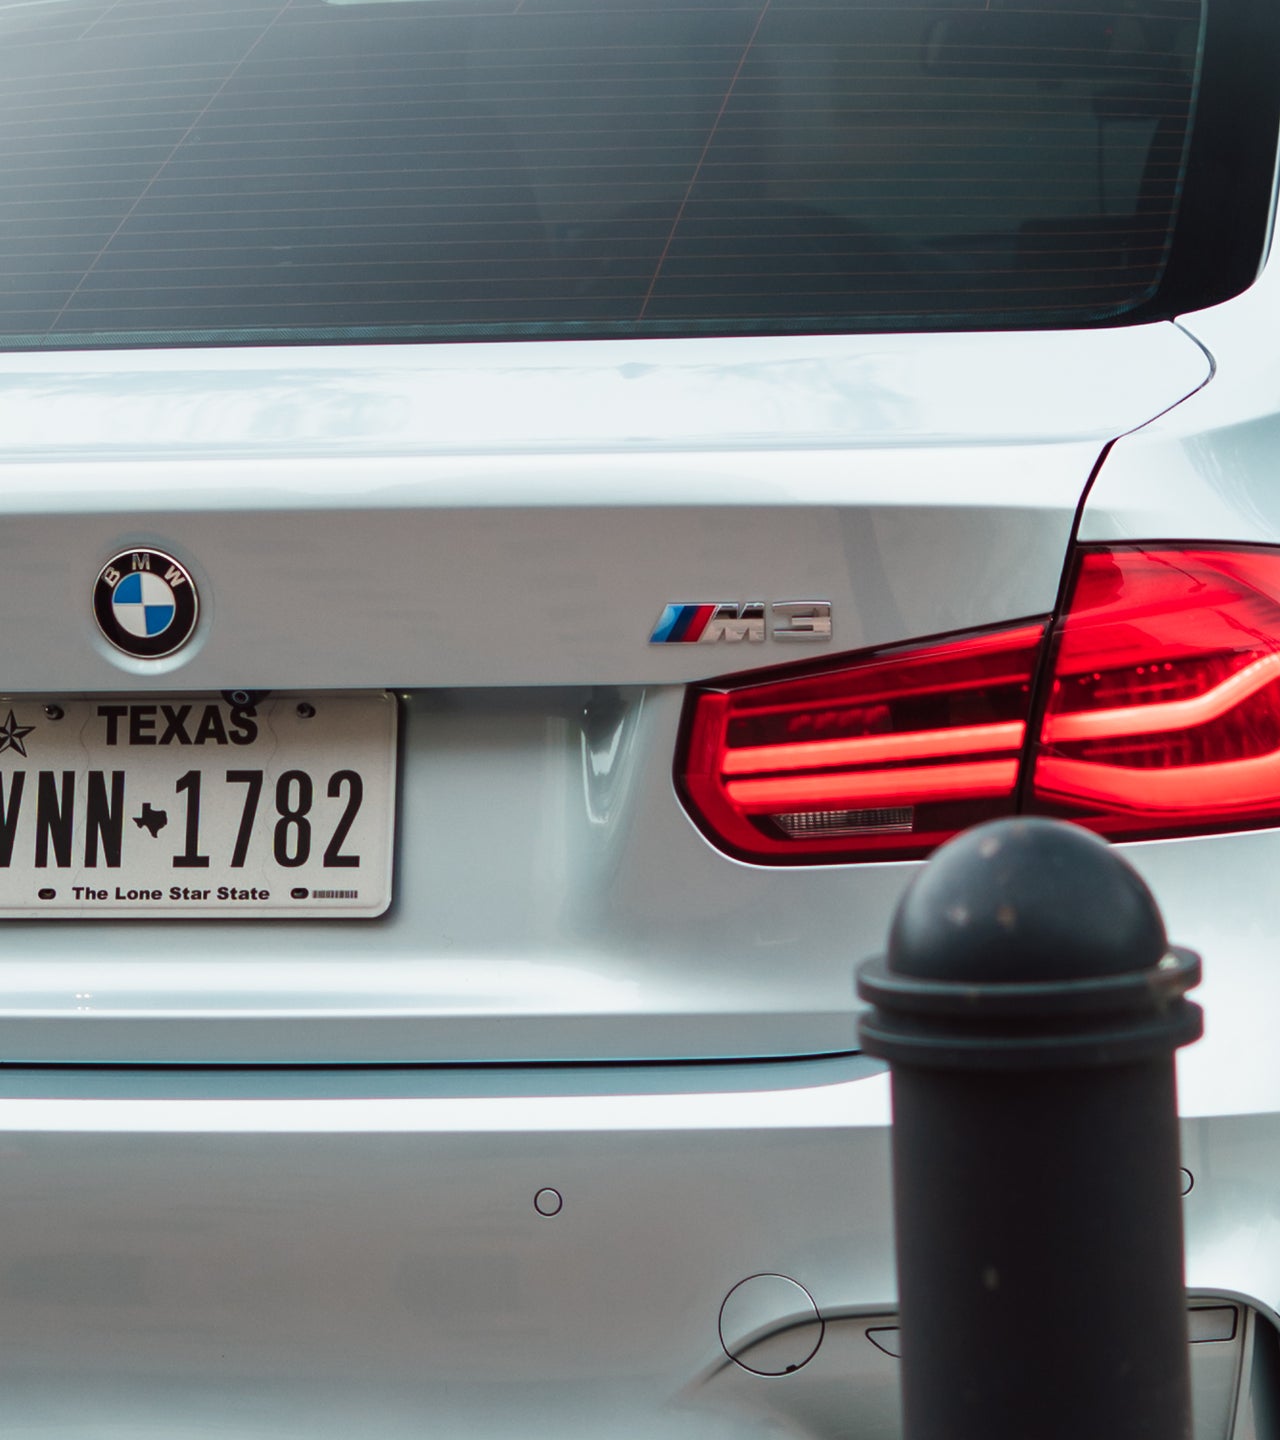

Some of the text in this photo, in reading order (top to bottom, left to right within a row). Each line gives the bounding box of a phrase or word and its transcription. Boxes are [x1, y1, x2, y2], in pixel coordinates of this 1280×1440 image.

[103, 553, 186, 588] BMW
[697, 599, 833, 643] M3
[97, 704, 258, 746] TEXAS
[172, 769, 364, 868] 1782
[72, 886, 270, 901] The Lone Star State
